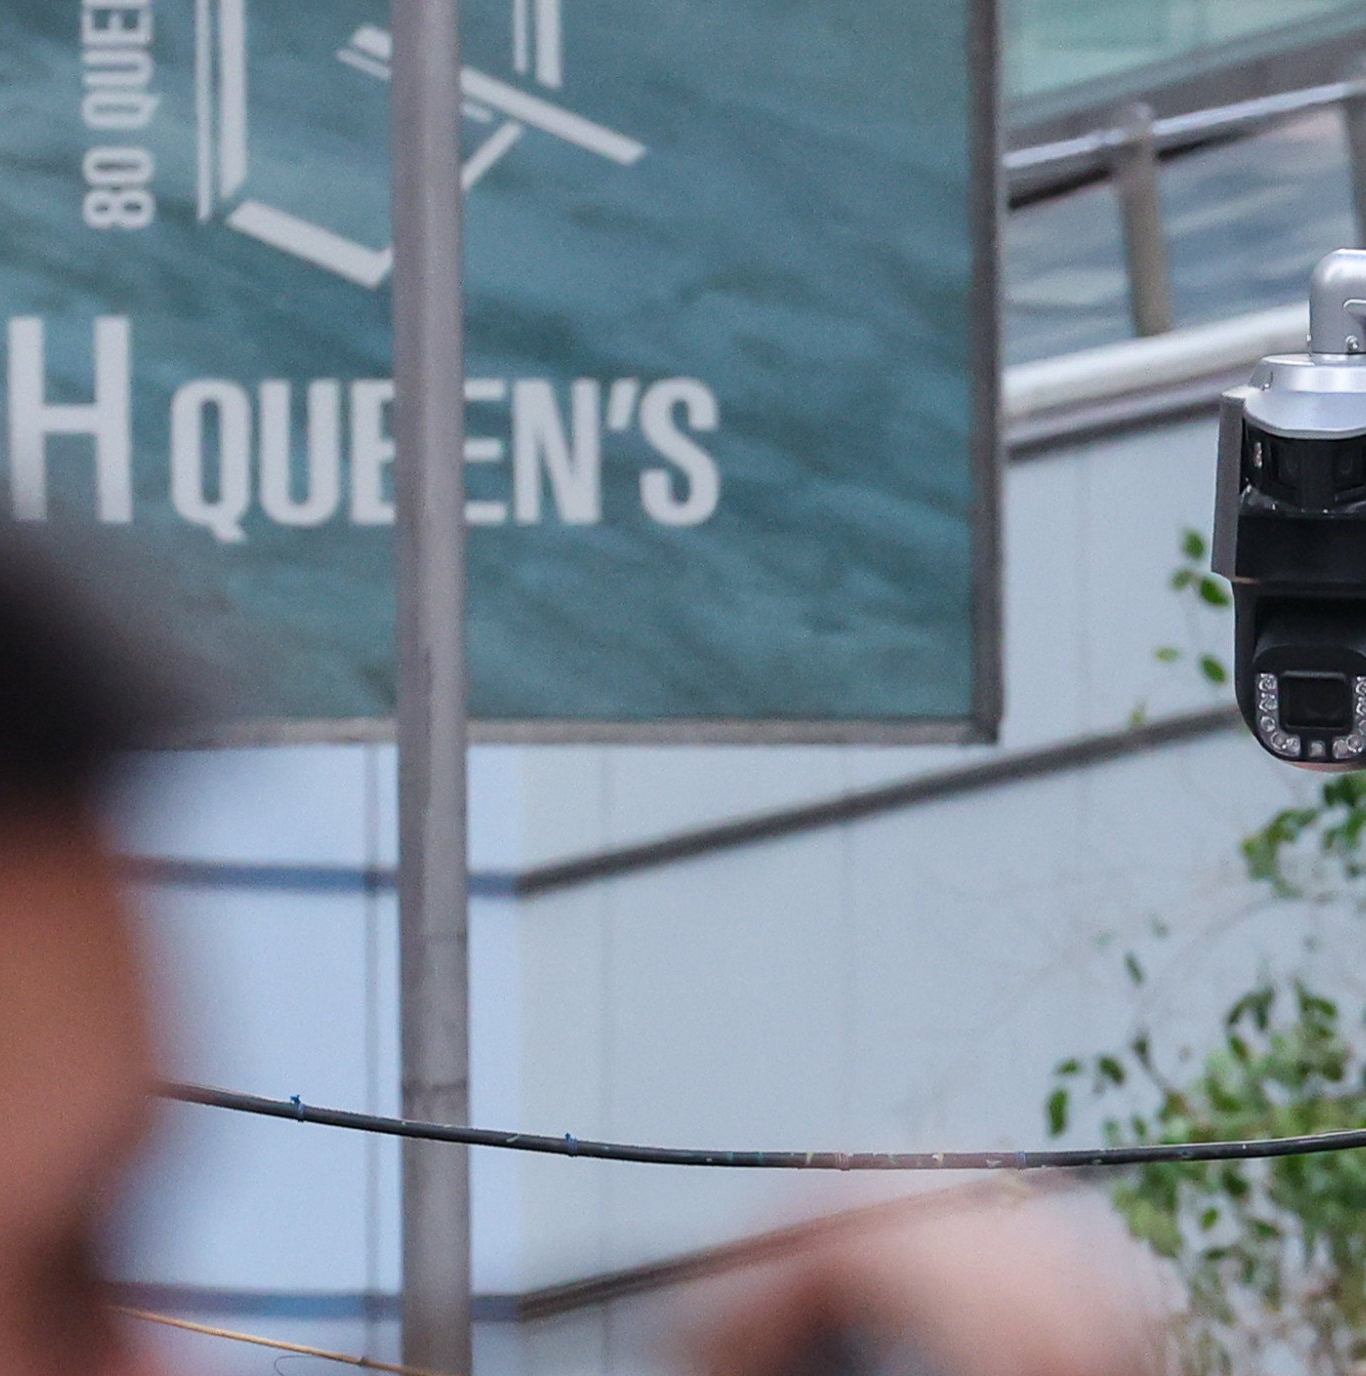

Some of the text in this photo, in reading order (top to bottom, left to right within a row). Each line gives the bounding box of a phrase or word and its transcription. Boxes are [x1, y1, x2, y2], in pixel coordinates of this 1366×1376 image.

[81, 0, 161, 230] 80 QUE
[7, 315, 132, 524] H
